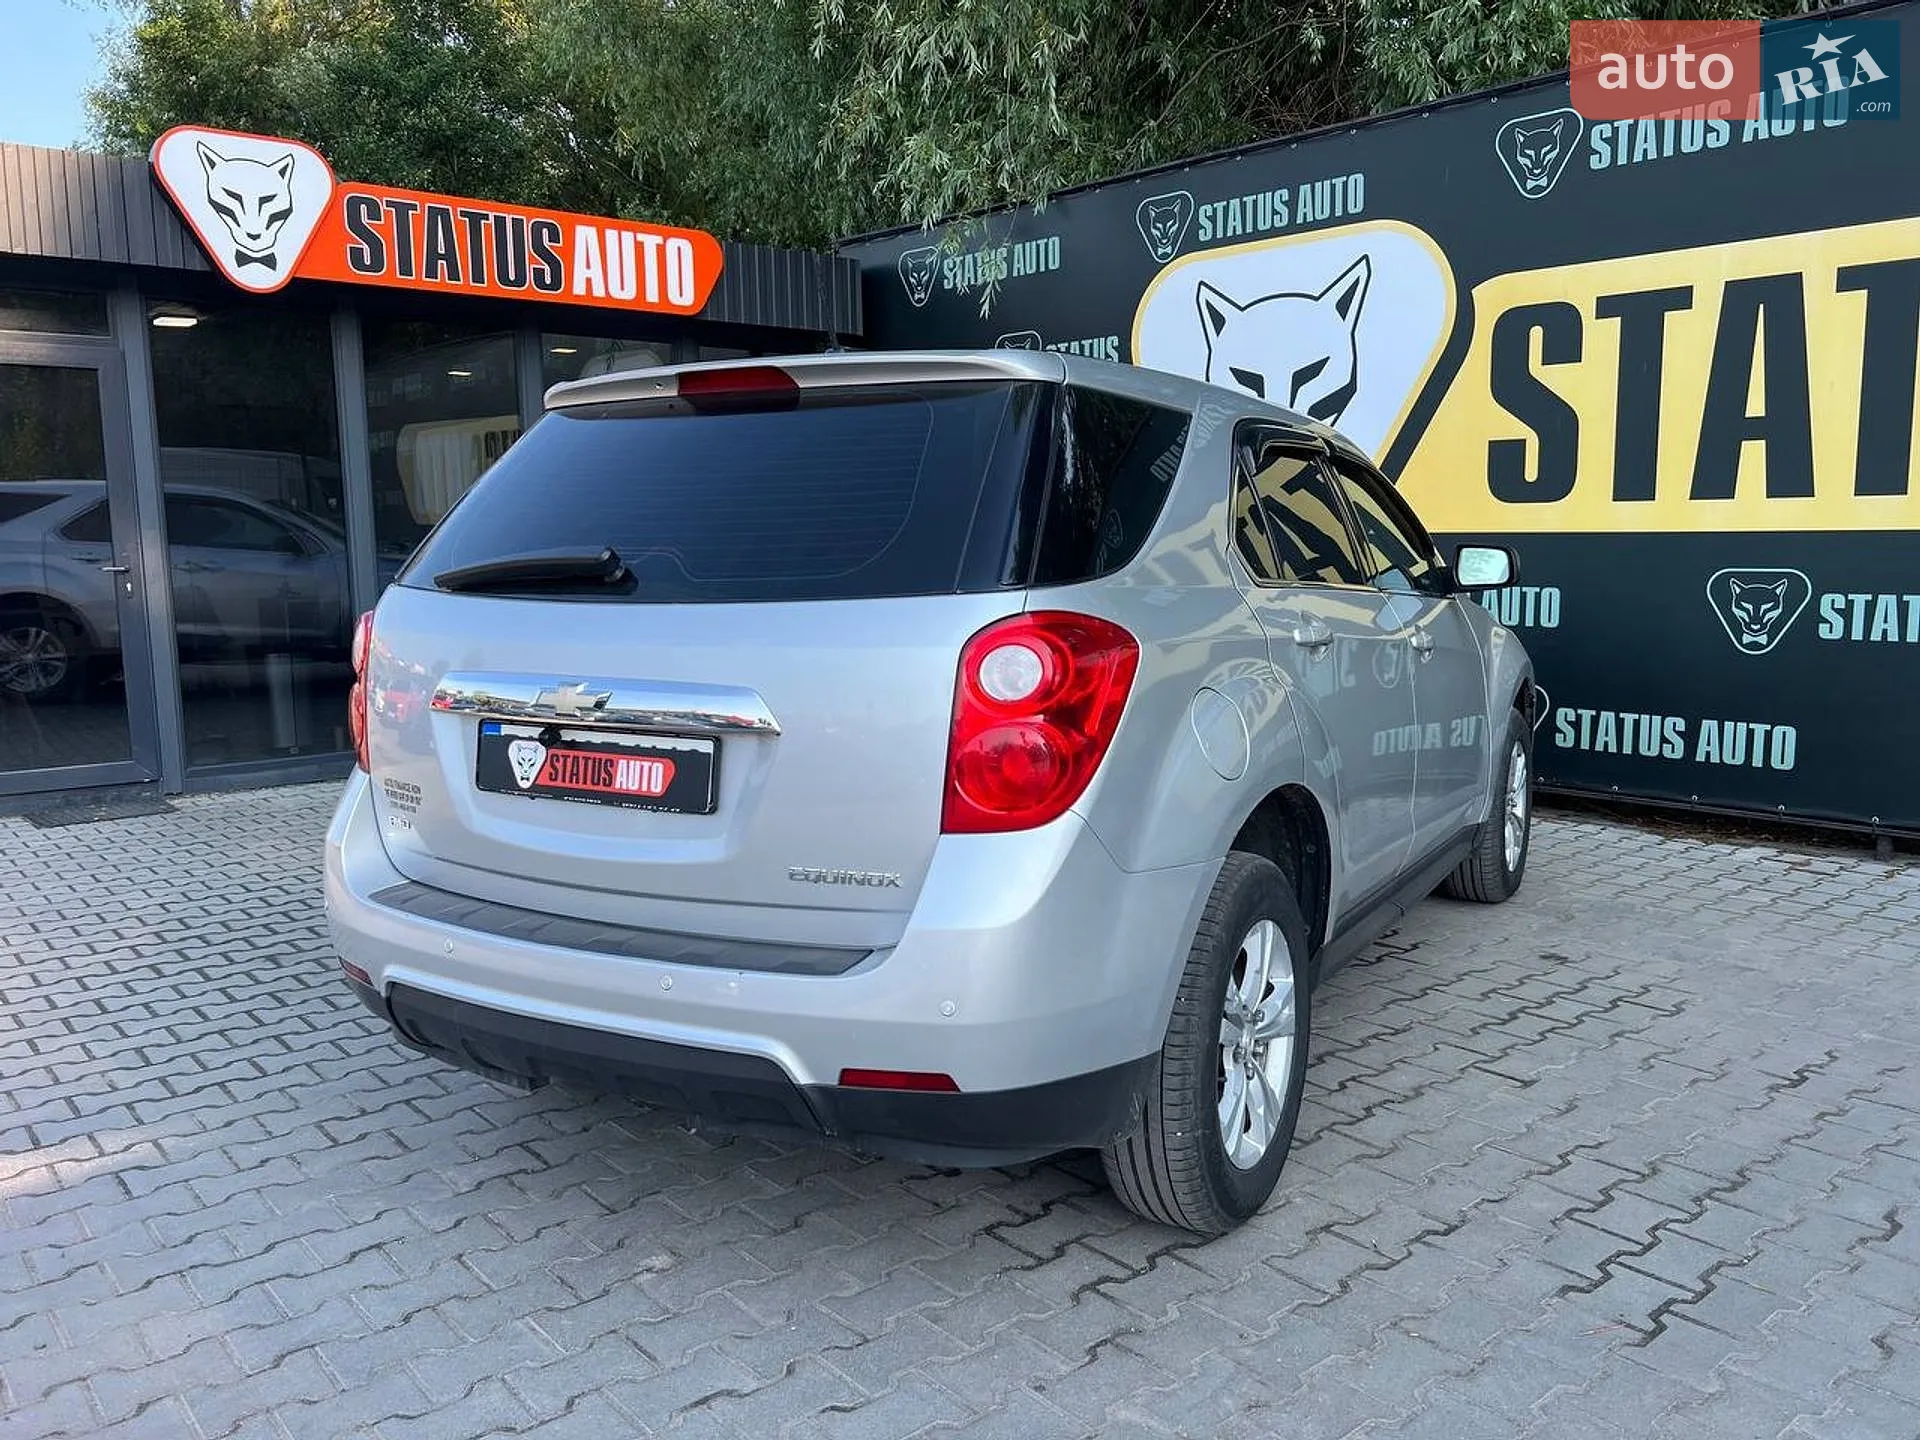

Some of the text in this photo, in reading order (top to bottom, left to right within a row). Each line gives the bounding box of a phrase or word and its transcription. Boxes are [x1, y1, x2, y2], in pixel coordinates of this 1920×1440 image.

[1198, 173, 1365, 242] STATUS AUTO
[344, 194, 696, 307] STATUS AUTO
[1012, 236, 1061, 277] AUTO
[1481, 586, 1561, 628] AUTO
[1555, 707, 1797, 771] STATUS AUTO
[548, 752, 665, 793] STATUS AUTO
[788, 866, 902, 889] EQUINOX
